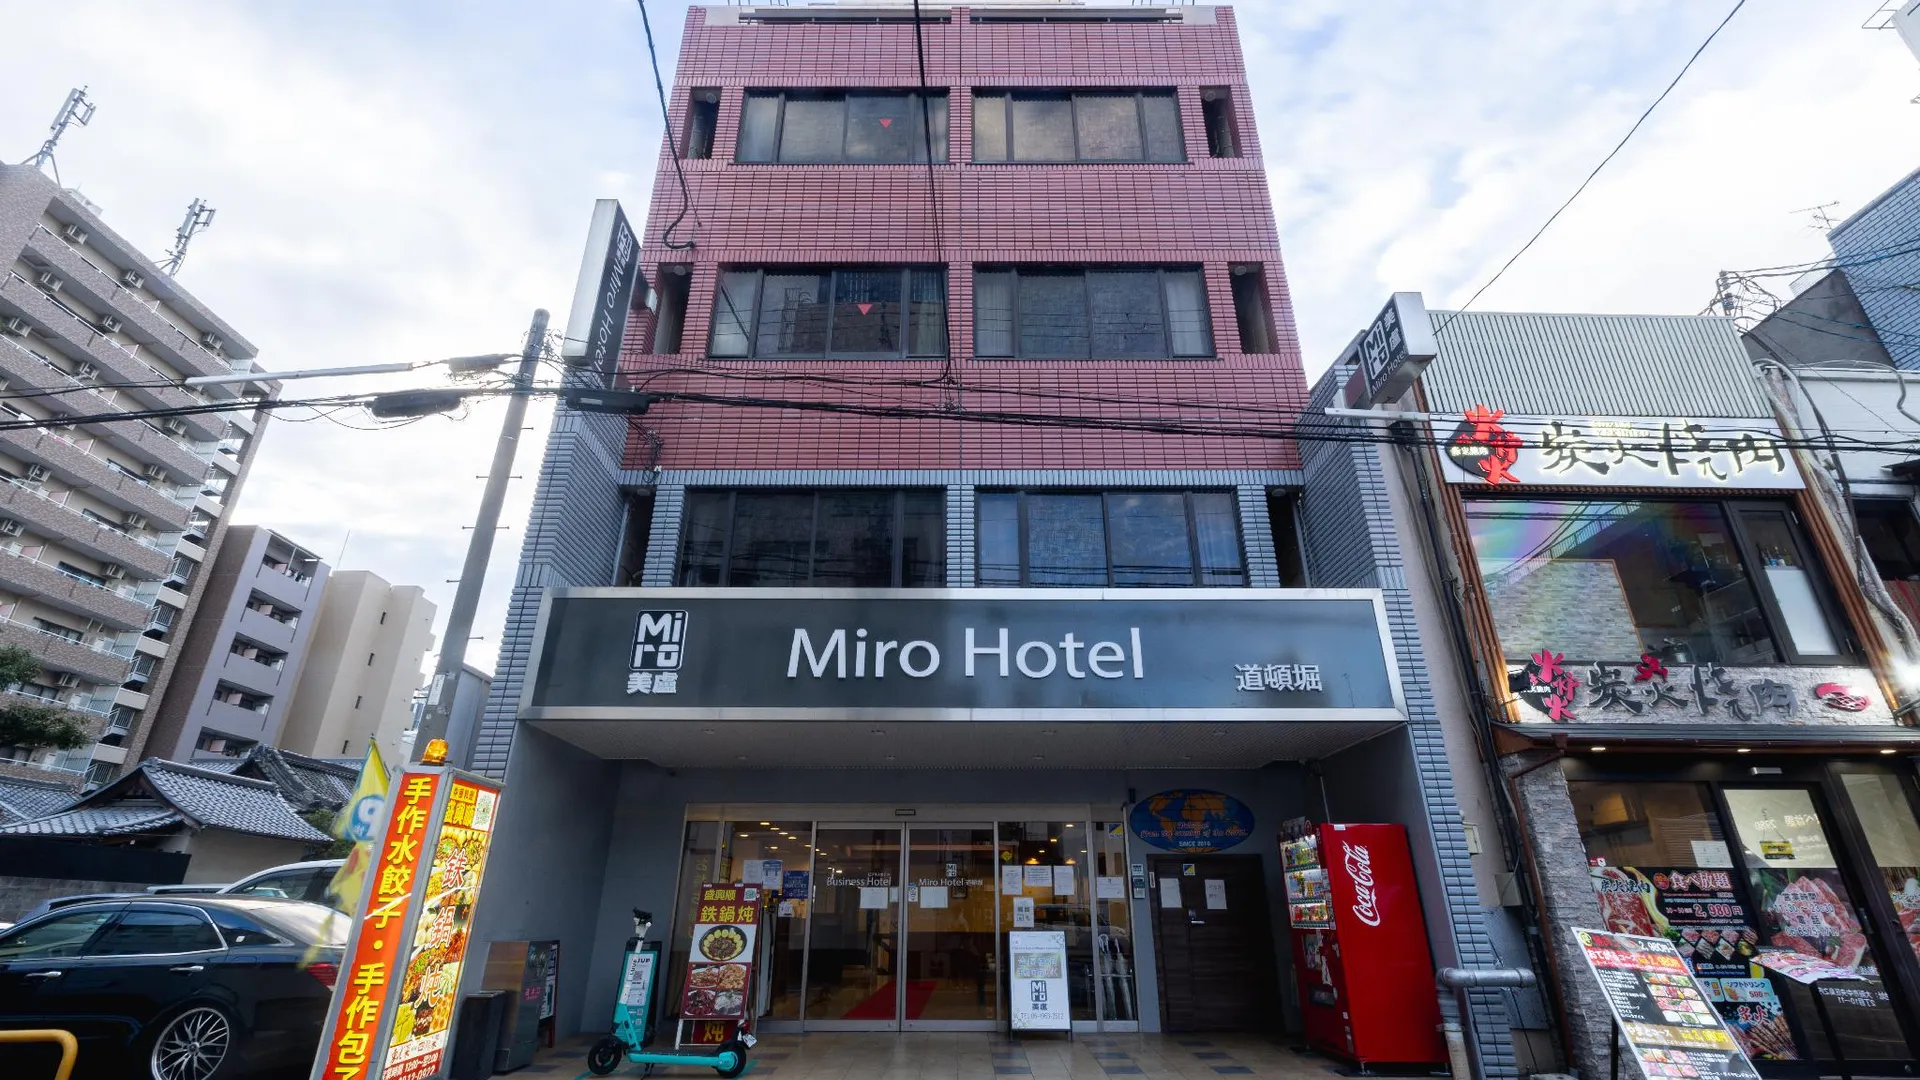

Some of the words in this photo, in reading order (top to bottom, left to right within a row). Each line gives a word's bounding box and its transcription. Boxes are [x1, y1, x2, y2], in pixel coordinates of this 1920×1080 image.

[787, 628, 940, 679] Miro
[965, 627, 1144, 679] Hotel
[1233, 663, 1323, 692] 道頓堀
[826, 877, 866, 886] Business
[867, 876, 892, 886] Hotel
[919, 878, 939, 886] Miro
[940, 877, 964, 886] Hotel
[1342, 840, 1381, 927] Coca-Cola
[1669, 870, 1733, 891] 食べ放題
